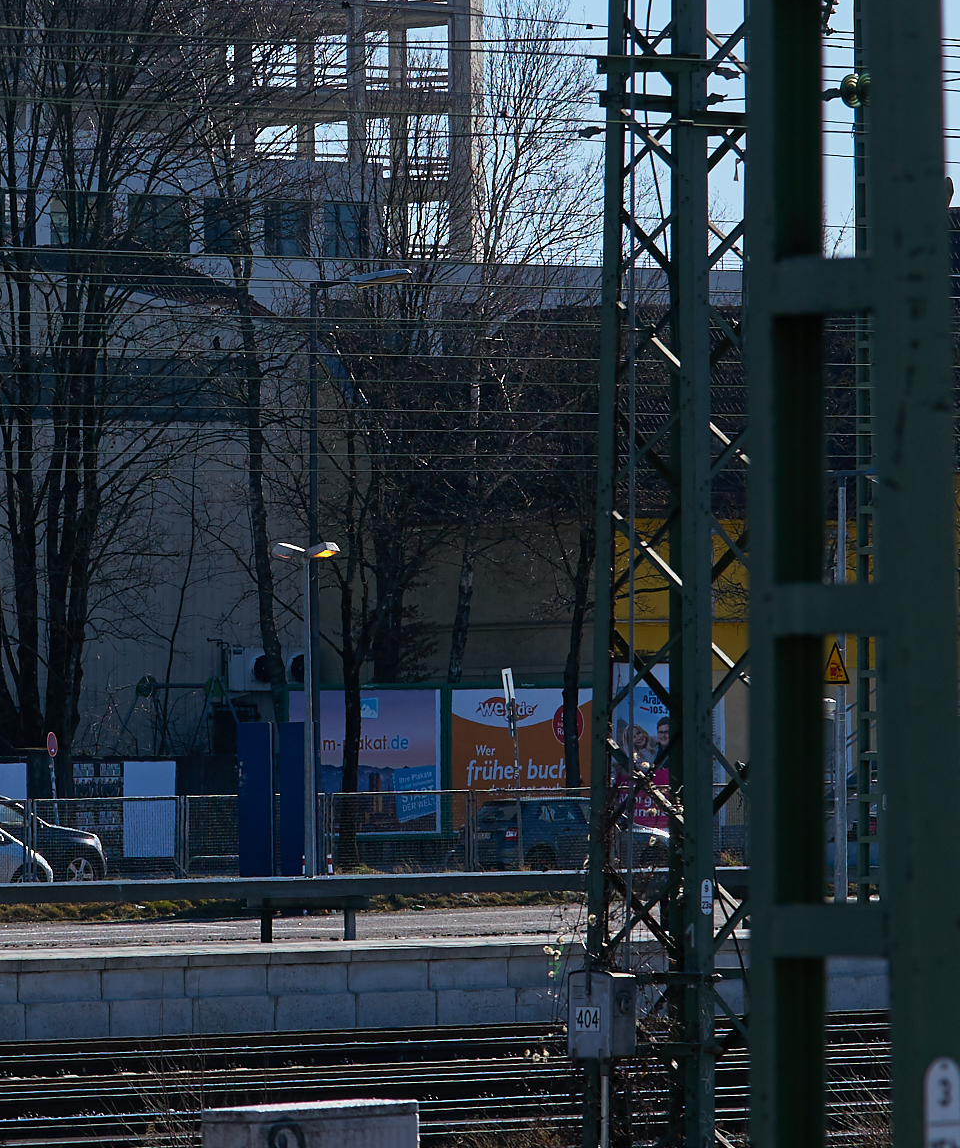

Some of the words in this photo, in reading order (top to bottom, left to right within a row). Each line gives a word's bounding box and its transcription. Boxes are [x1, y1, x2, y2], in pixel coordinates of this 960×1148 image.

[322, 735, 409, 751] m-akat.de
[475, 744, 496, 756] Wer
[402, 803, 416, 812] DER
[704, 884, 709, 893] 9
[577, 1009, 599, 1029] 404
